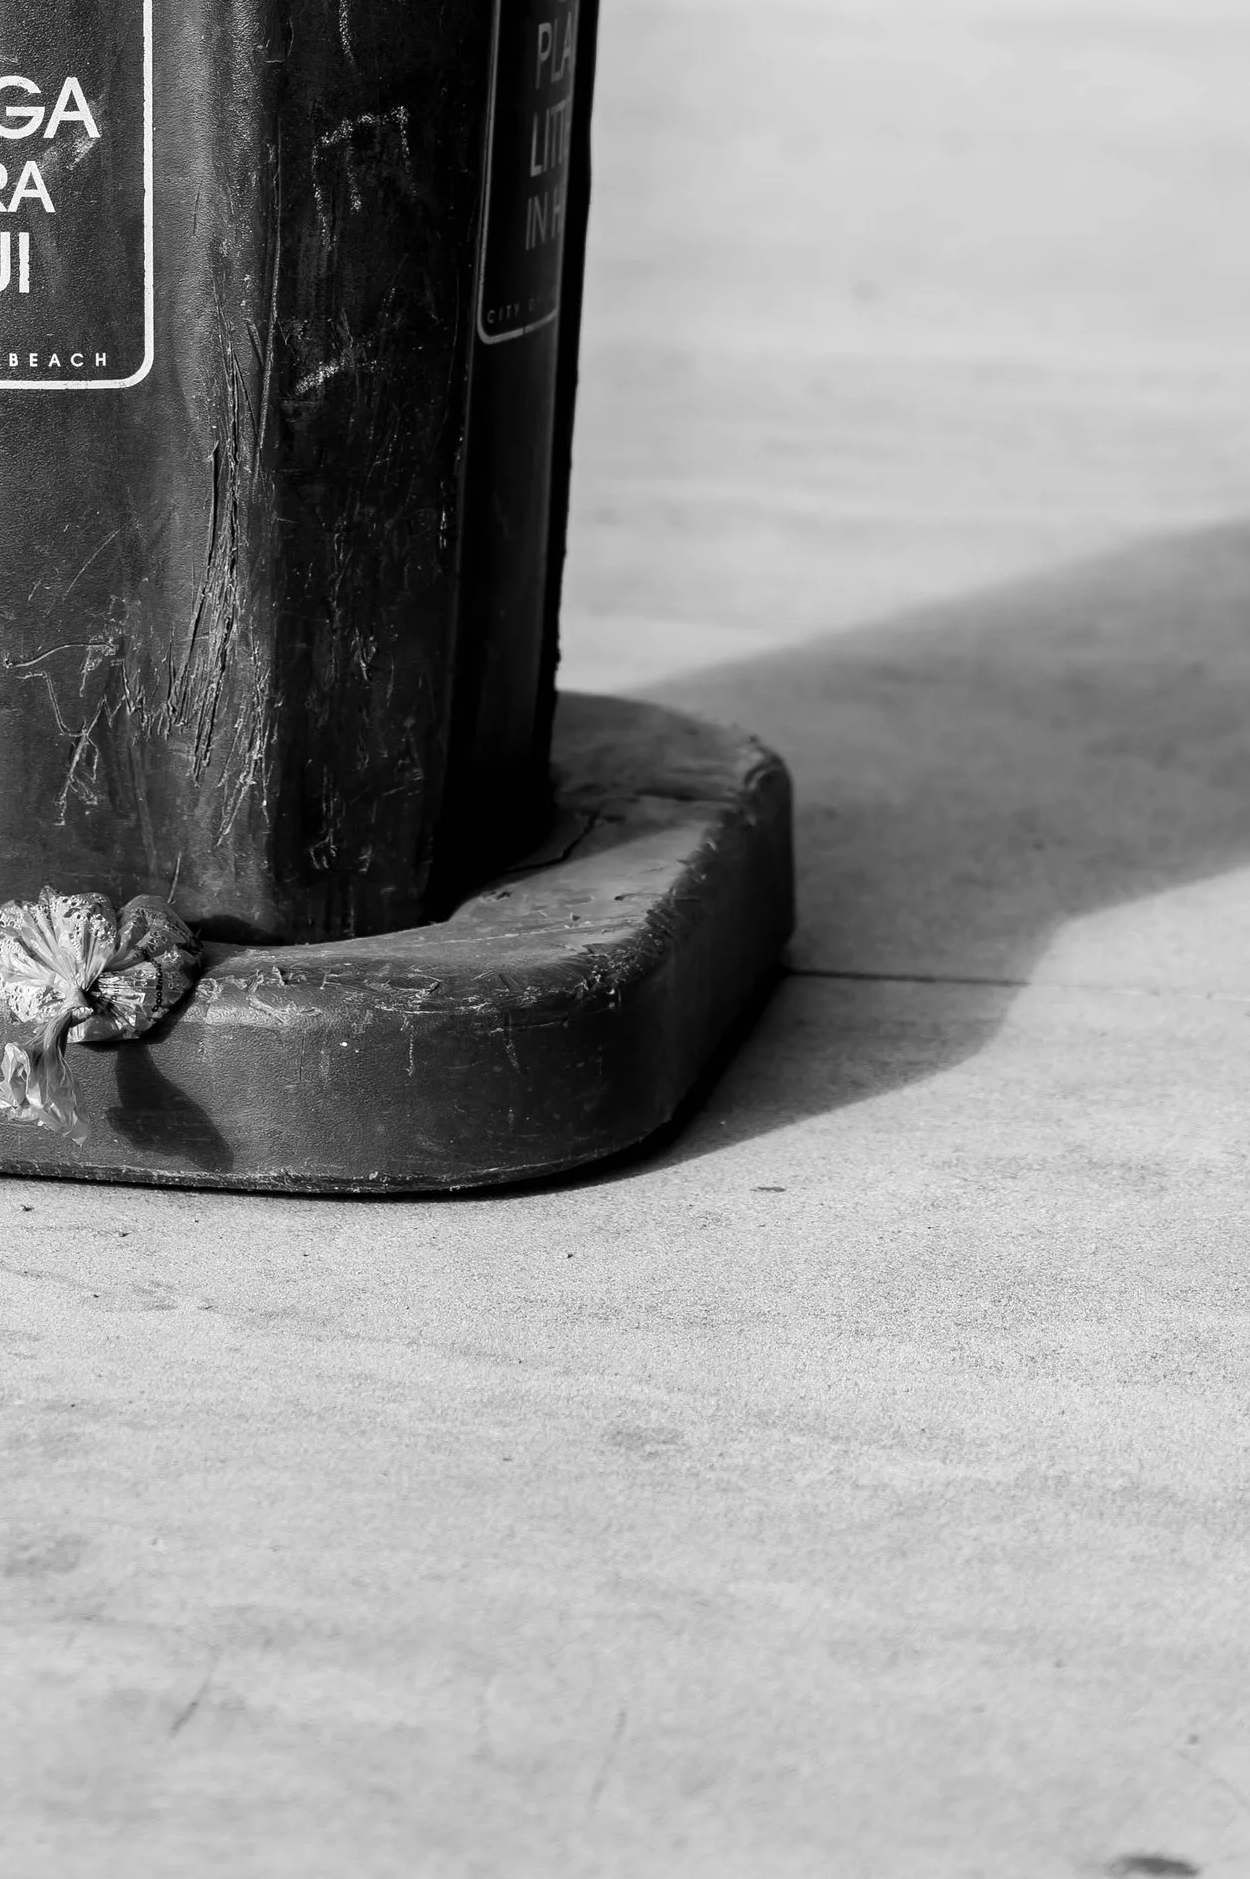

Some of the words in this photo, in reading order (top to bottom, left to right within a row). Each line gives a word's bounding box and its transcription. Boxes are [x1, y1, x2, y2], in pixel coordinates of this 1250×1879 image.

[525, 190, 549, 251] IN
[485, 300, 520, 325] CITY
[8, 352, 107, 368] BEACH
